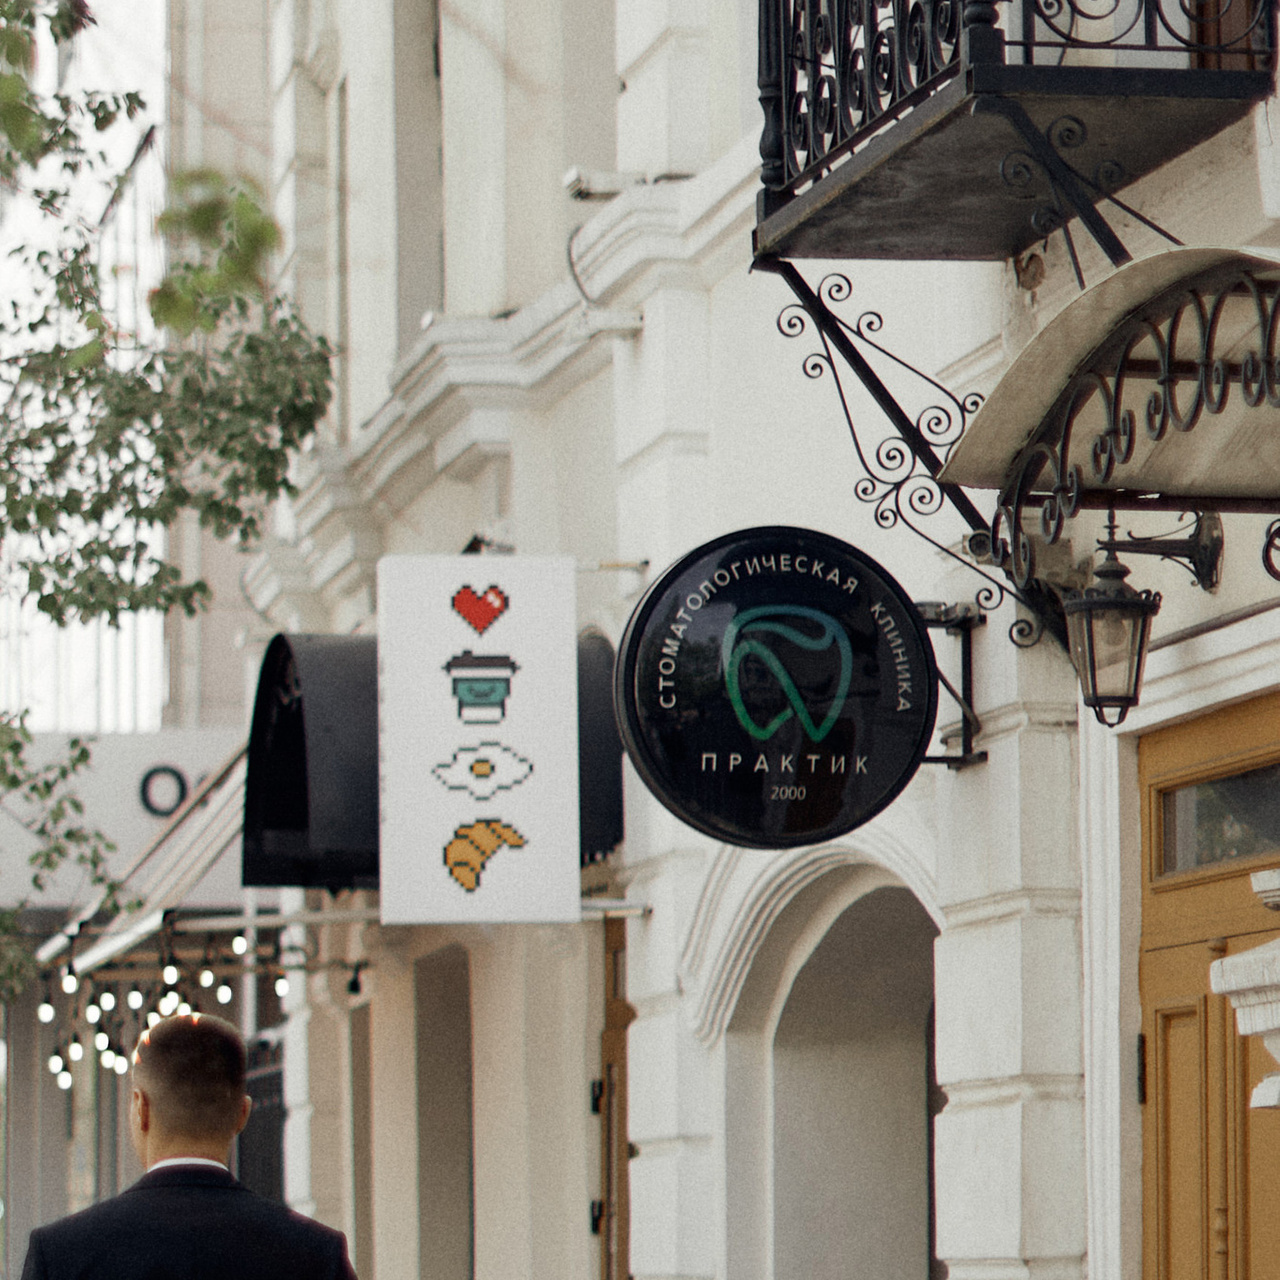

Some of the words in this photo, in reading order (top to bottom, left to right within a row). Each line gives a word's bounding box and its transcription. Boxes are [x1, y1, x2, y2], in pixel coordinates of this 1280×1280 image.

[659, 554, 859, 709] СТОМАТОЛОГИЧЕСКАЯ
[871, 602, 913, 712] КЛИНИКА
[701, 753, 868, 774] ПРАКТИК
[771, 786, 806, 801] 2000
